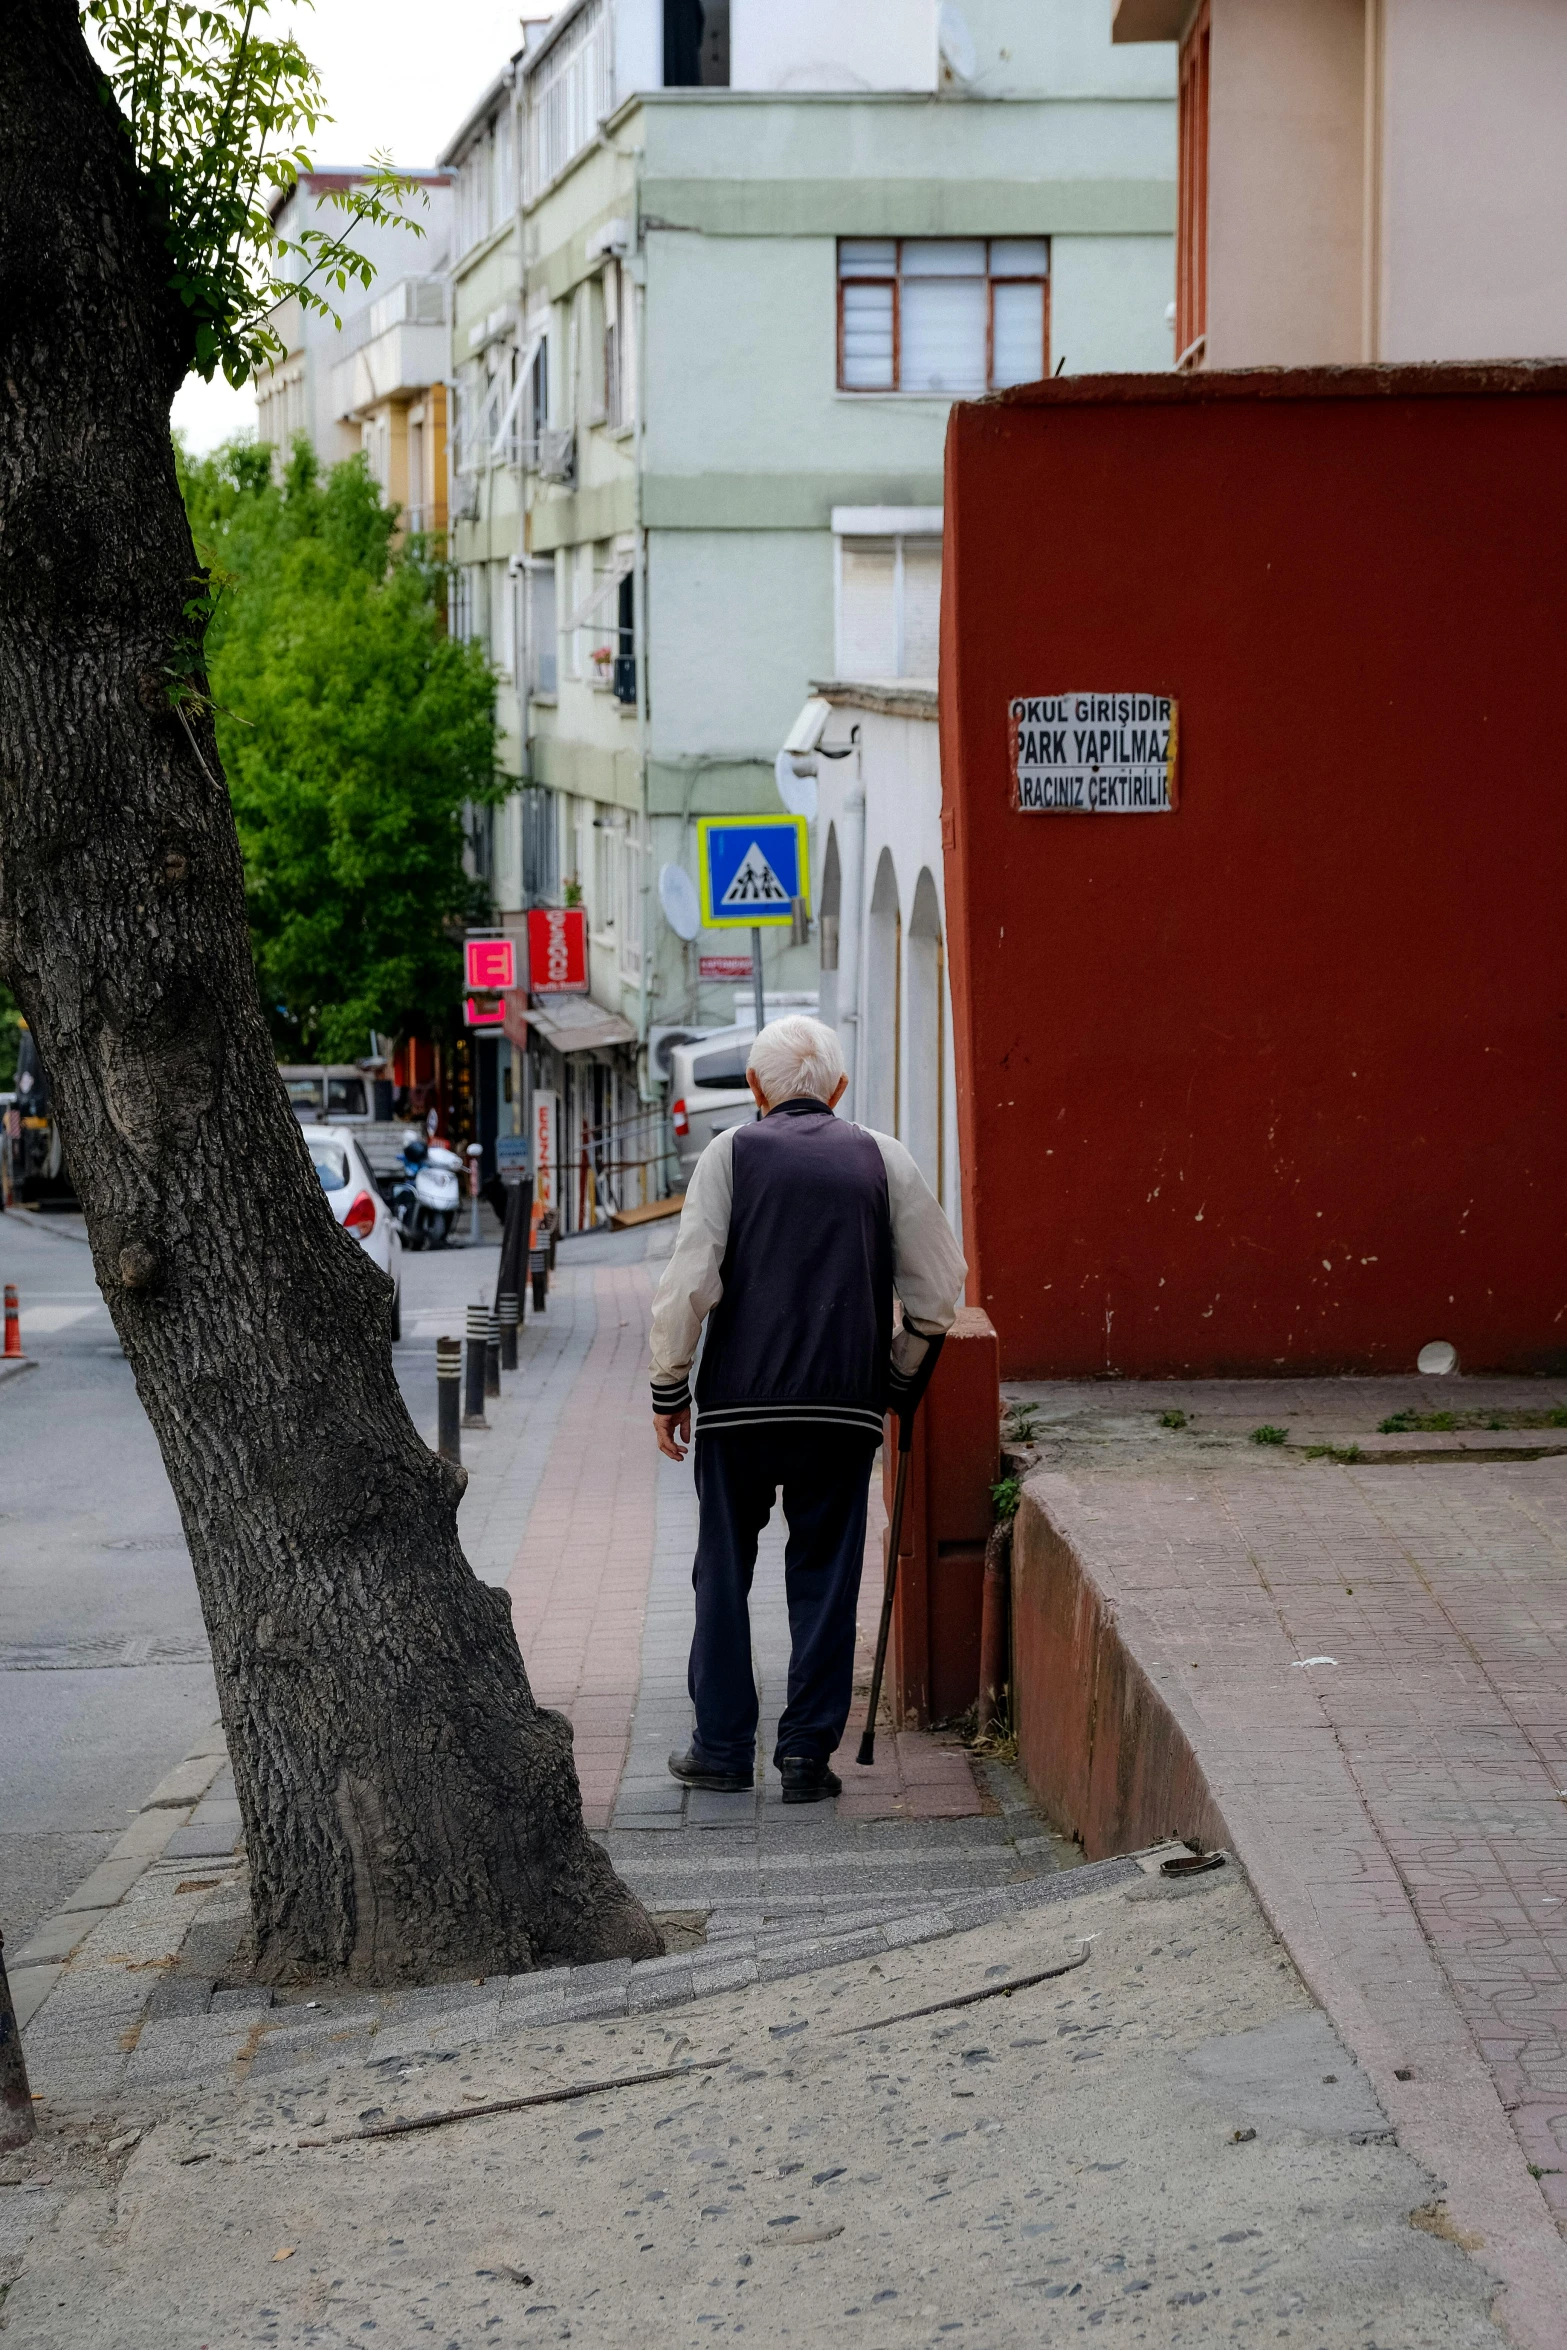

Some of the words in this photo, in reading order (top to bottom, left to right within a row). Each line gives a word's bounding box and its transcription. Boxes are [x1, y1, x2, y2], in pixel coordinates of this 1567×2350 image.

[1012, 699, 1069, 723] OKUL
[1075, 694, 1171, 728] GİRİŞİDİR
[1018, 730, 1067, 764] PARK
[1073, 729, 1172, 764] YAPILMAZ
